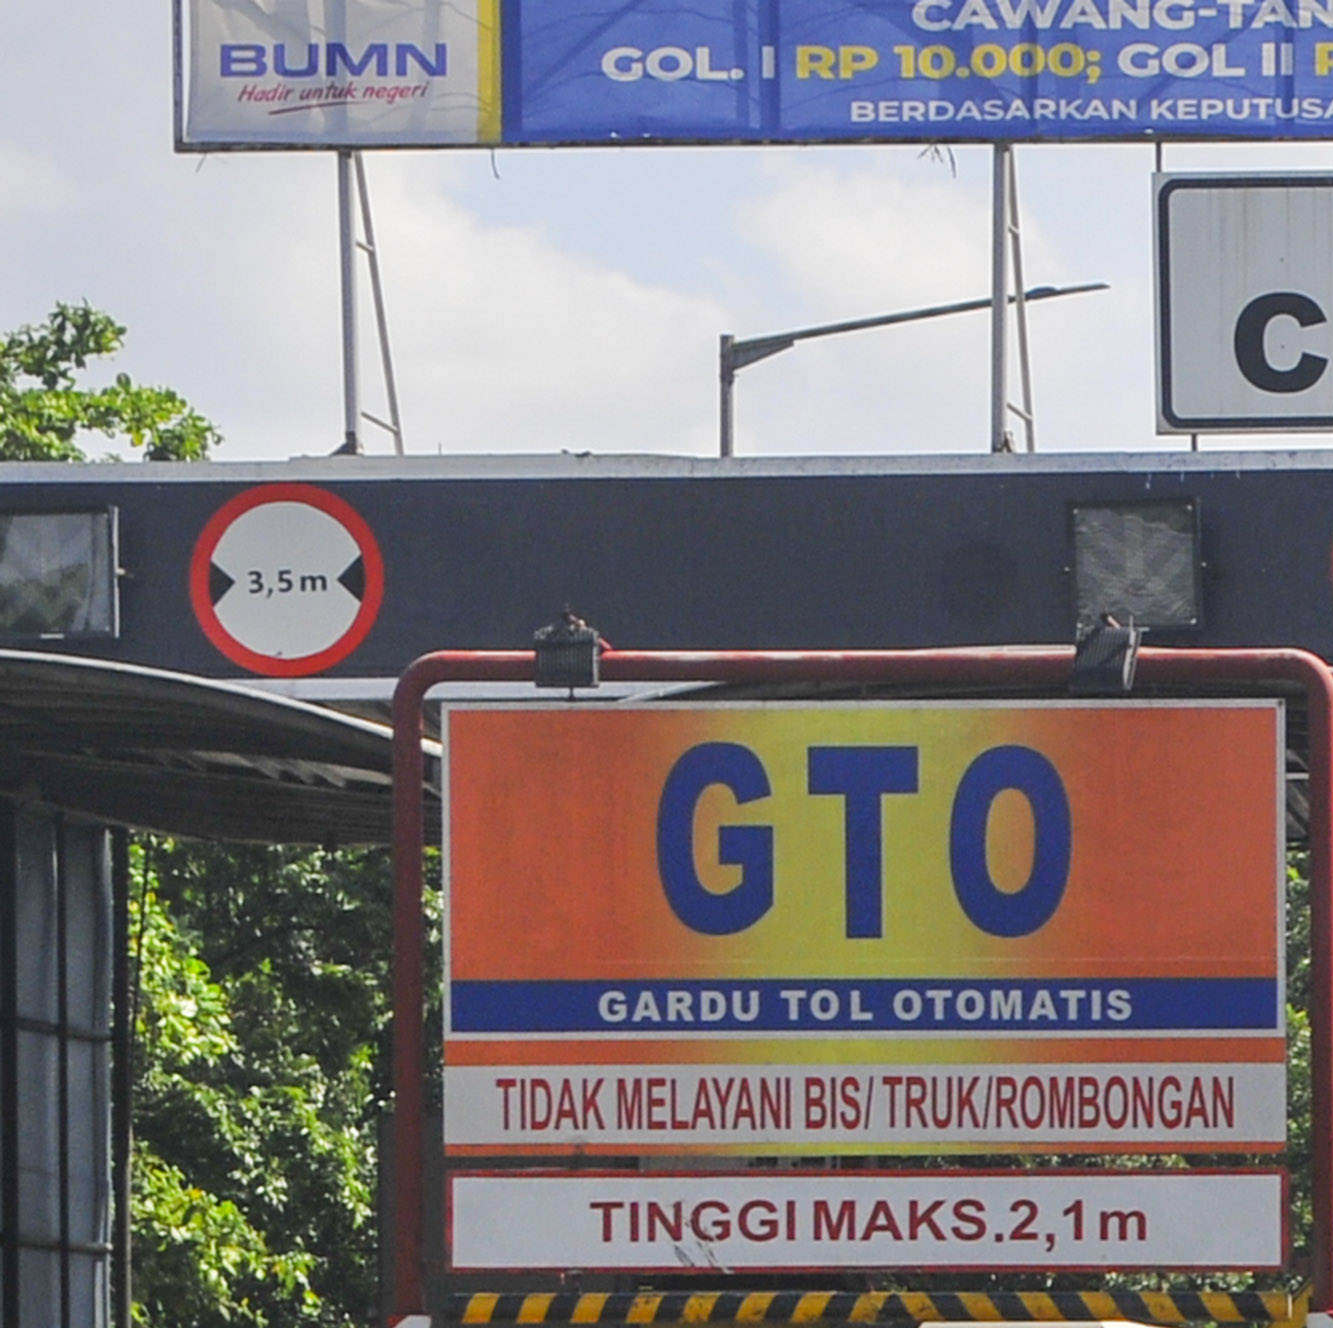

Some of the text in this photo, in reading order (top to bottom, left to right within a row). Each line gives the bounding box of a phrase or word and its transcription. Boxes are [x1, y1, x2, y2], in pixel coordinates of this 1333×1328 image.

[220, 43, 447, 77] BUMN
[601, 46, 745, 81] GOL.
[762, 46, 775, 79] I
[795, 46, 879, 80] RP
[893, 43, 1100, 83] 10.000;
[1116, 42, 1245, 78] GOL
[1262, 43, 1294, 76] II
[237, 81, 430, 104] Hadir untuk negeri
[850, 98, 1139, 123] BERDASARKAN
[656, 740, 1073, 940] GTO
[598, 988, 1134, 1024] GARDU TOL OTOMATIS
[495, 1077, 605, 1132] TIDAK
[616, 1076, 792, 1132] MELAYANI
[884, 1074, 1235, 1132] TRUK/ROMBONGAN
[590, 1200, 797, 1244] TINGGI
